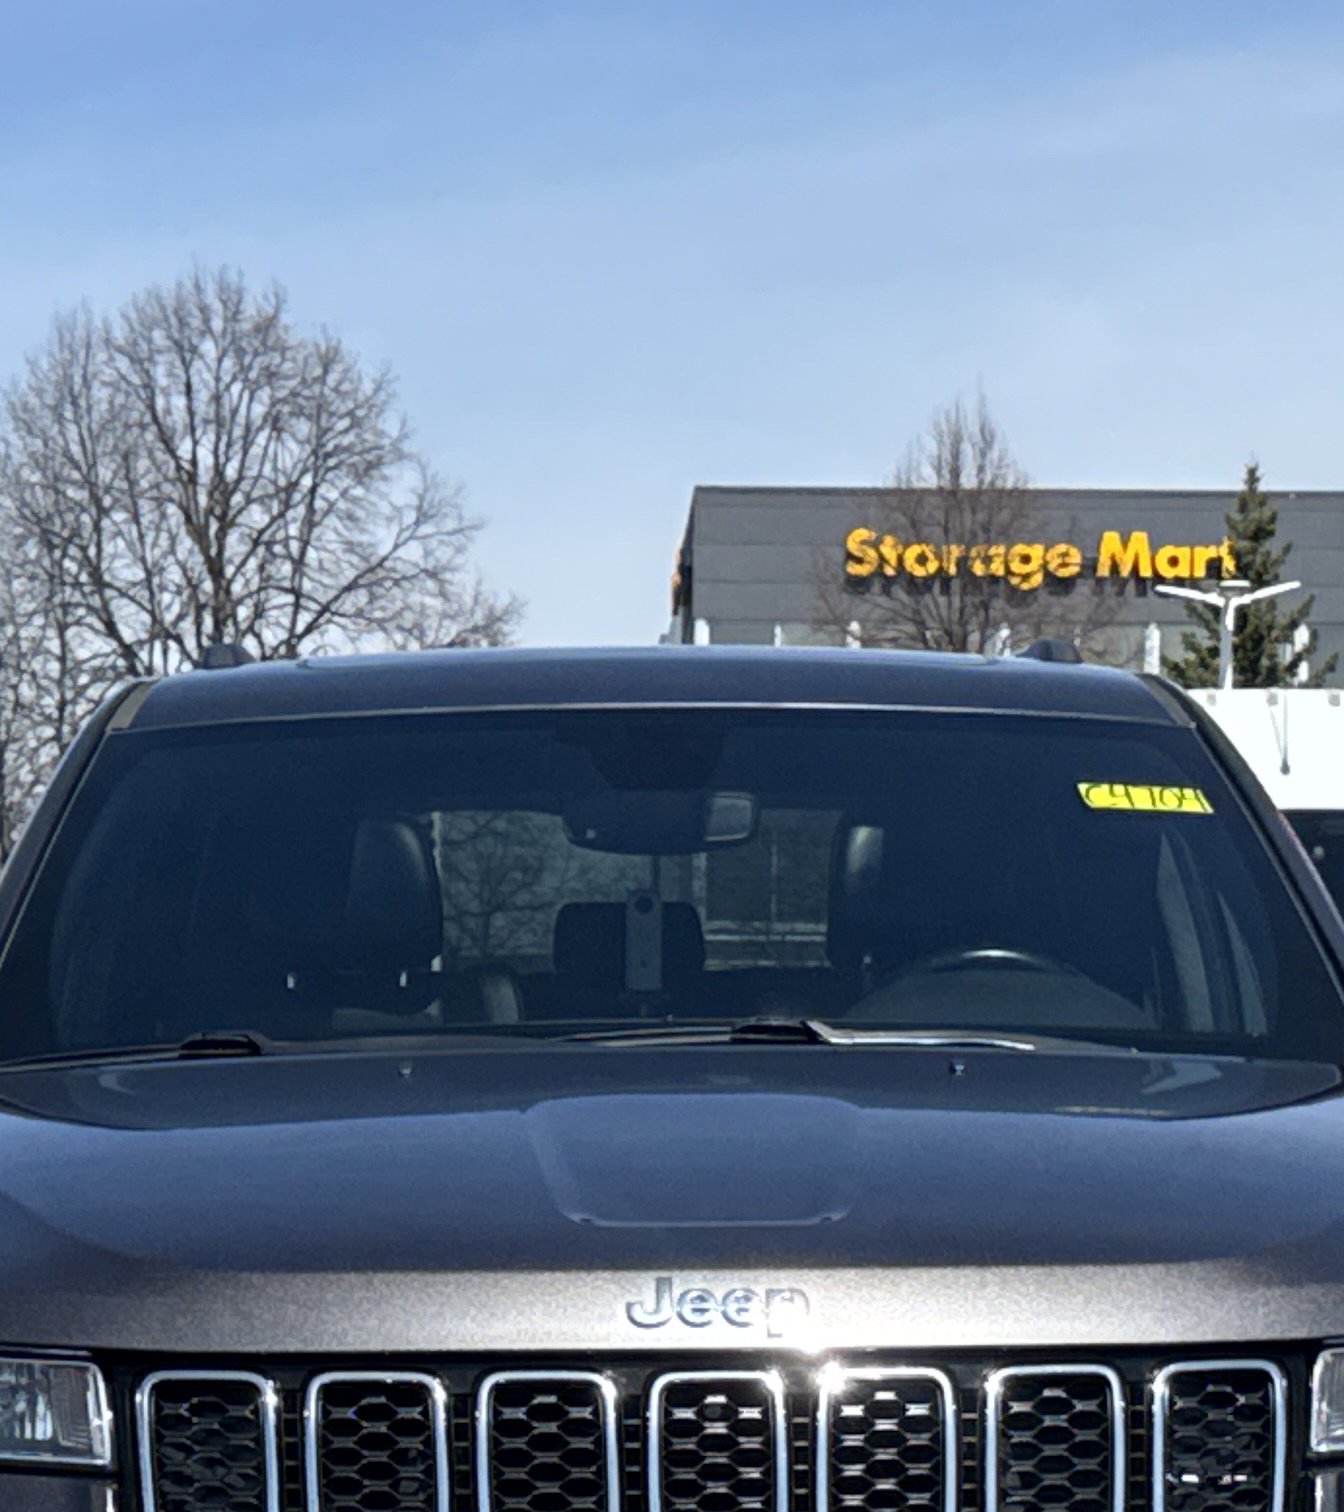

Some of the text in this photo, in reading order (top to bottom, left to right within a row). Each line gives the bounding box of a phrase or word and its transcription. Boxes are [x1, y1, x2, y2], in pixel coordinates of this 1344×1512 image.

[845, 527, 1237, 591] Storage Mart
[625, 1276, 811, 1338] Jeep
